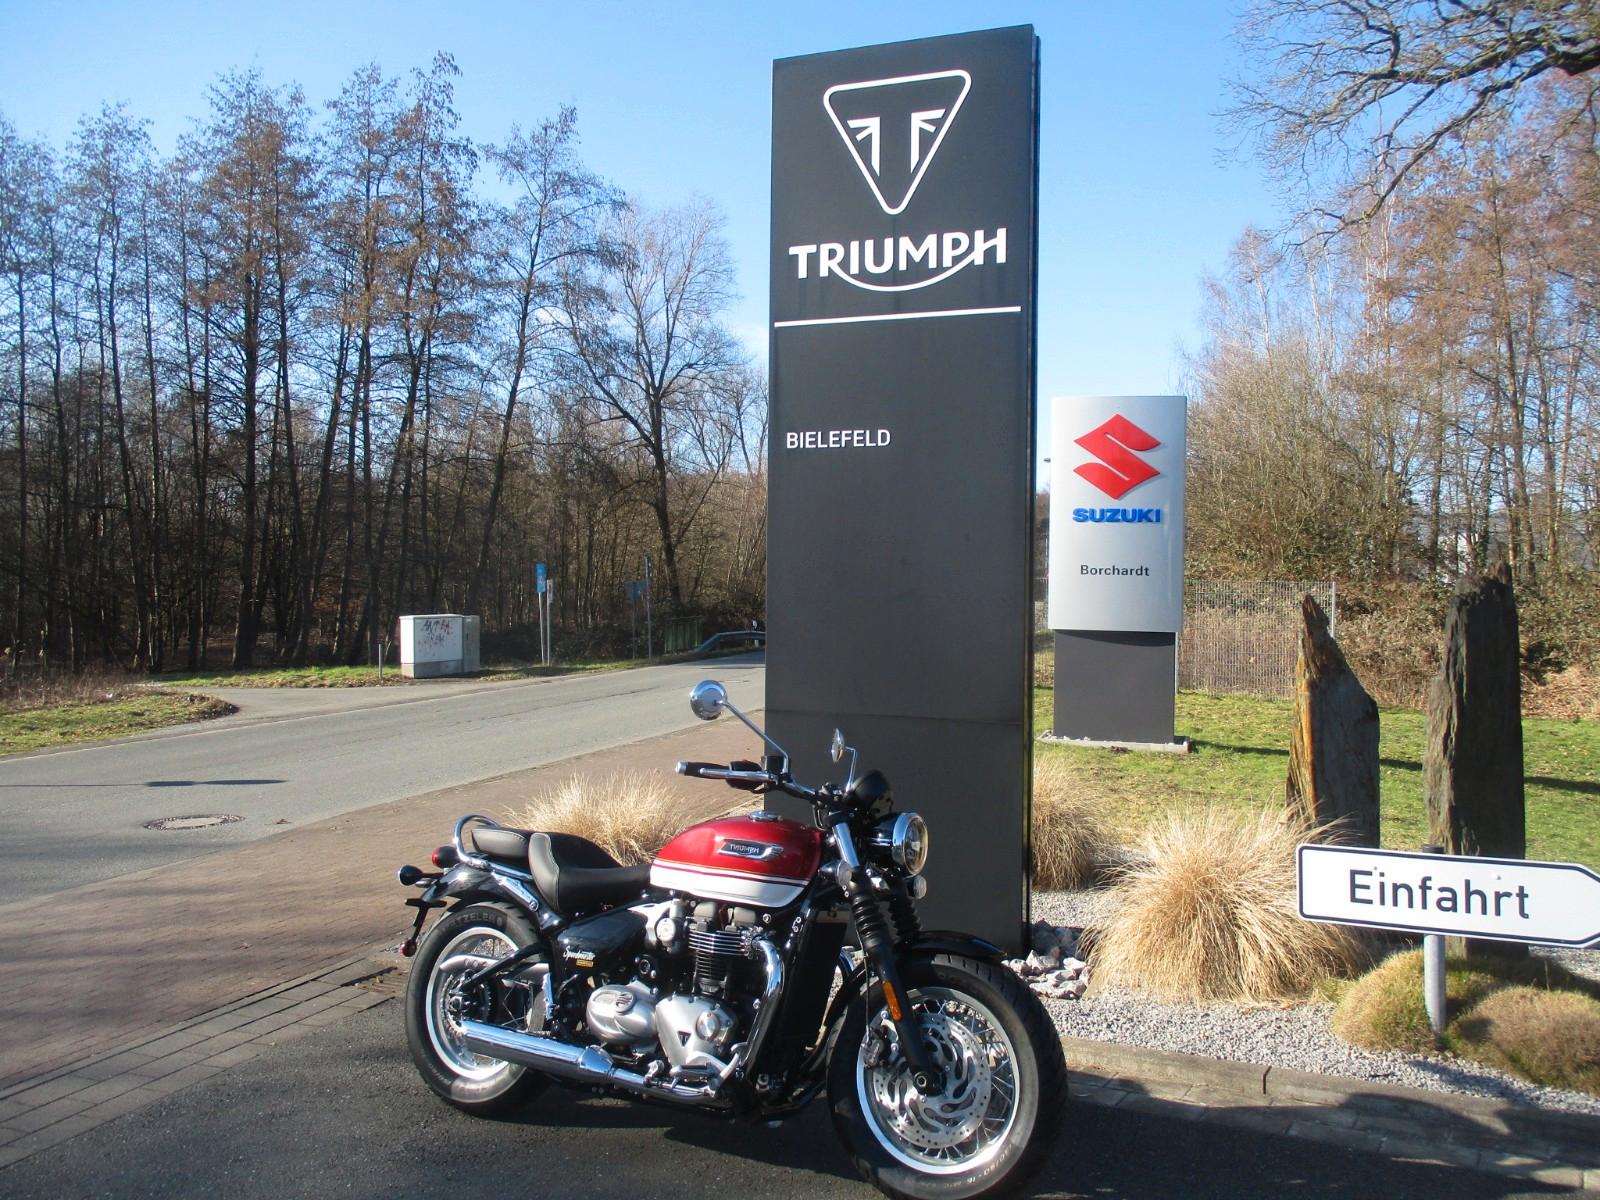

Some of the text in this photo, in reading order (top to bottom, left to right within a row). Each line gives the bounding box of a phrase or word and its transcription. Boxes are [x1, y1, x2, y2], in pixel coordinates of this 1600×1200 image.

[789, 228, 1007, 291] TRIUMPH
[786, 429, 891, 449] BIELEFELD
[1072, 508, 1161, 523] SUZUKI
[1080, 564, 1150, 577] Borchardt
[730, 843, 760, 855] TRIUMPH
[1350, 869, 1529, 919] Einfahrt
